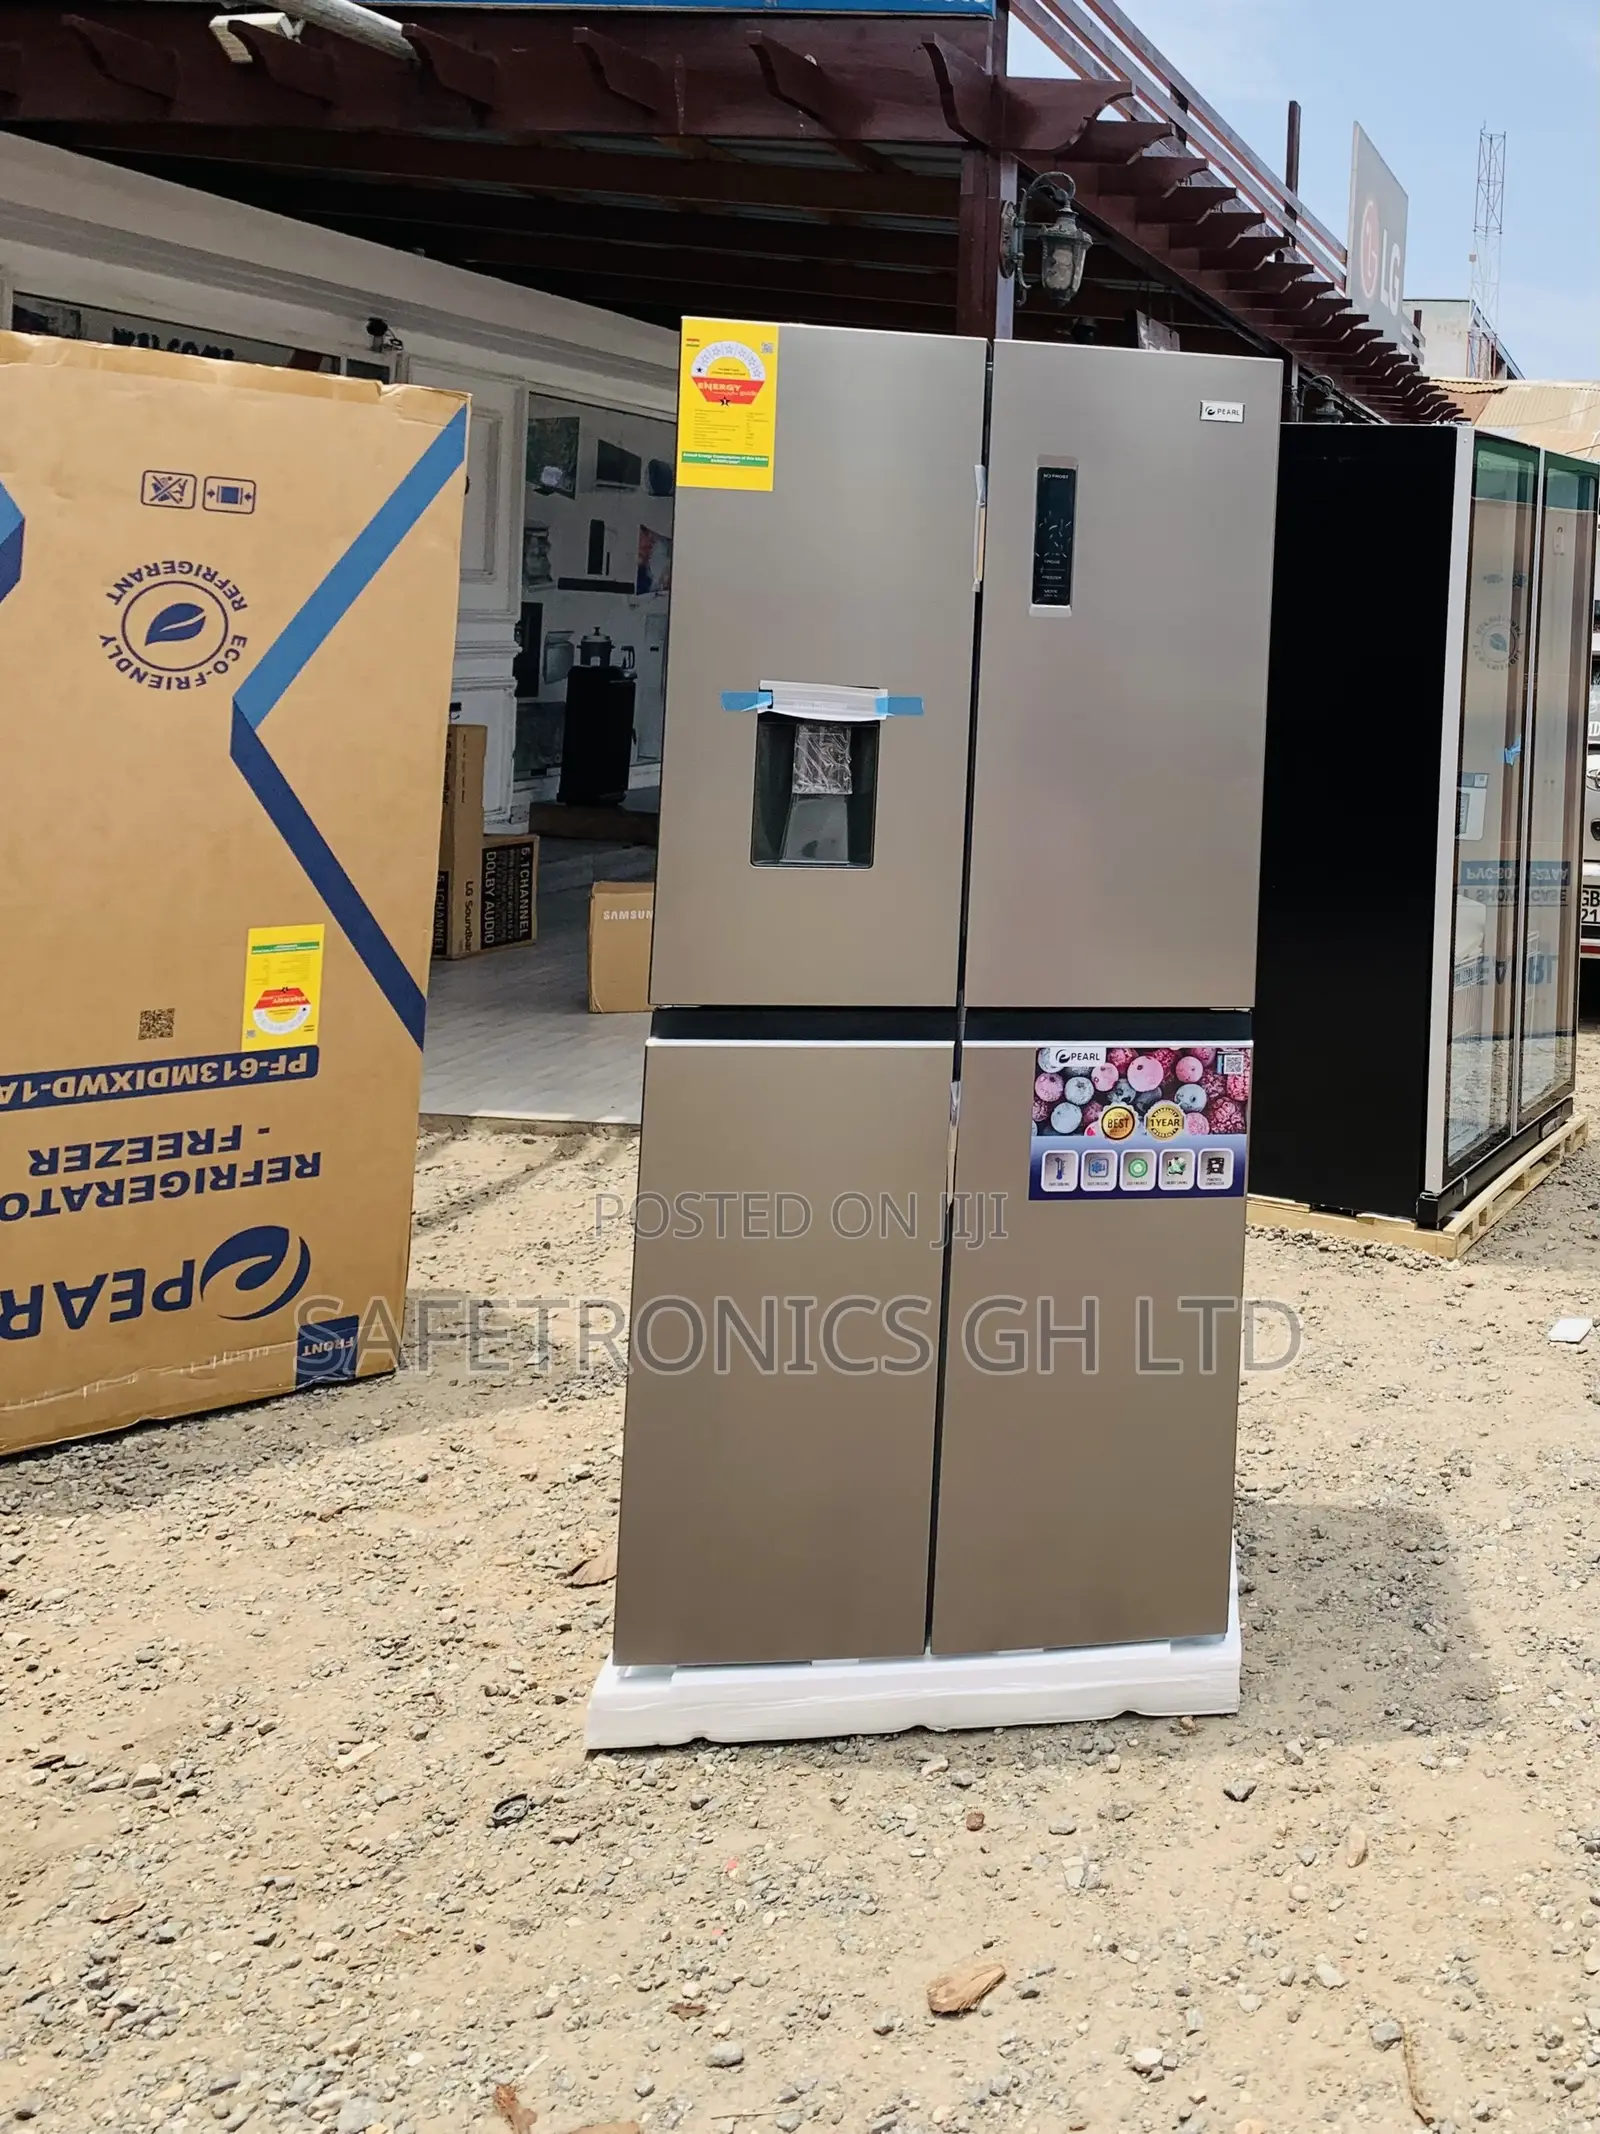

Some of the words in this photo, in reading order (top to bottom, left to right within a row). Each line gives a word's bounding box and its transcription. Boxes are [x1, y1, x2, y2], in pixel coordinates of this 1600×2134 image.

[1380, 228, 1400, 317] LG
[1217, 408, 1240, 416] PEARL
[106, 560, 248, 612] REFRIGERANT
[99, 634, 248, 691] ECO-FRIENDLY
[465, 880, 474, 897] LG
[484, 851, 496, 897] DOLBY
[434, 874, 445, 953] 51CHANNEL
[463, 900, 474, 953] Soundbar
[483, 901, 495, 944] AUDIO
[1071, 1052, 1101, 1061] PEARL
[1107, 1118, 1129, 1129] BEST
[28, 1124, 243, 1177] FREEZER
[0, 1152, 322, 1222] REFRIGERATO
[0, 1259, 196, 1341] PEAR
[302, 1336, 355, 1357] FRONT
